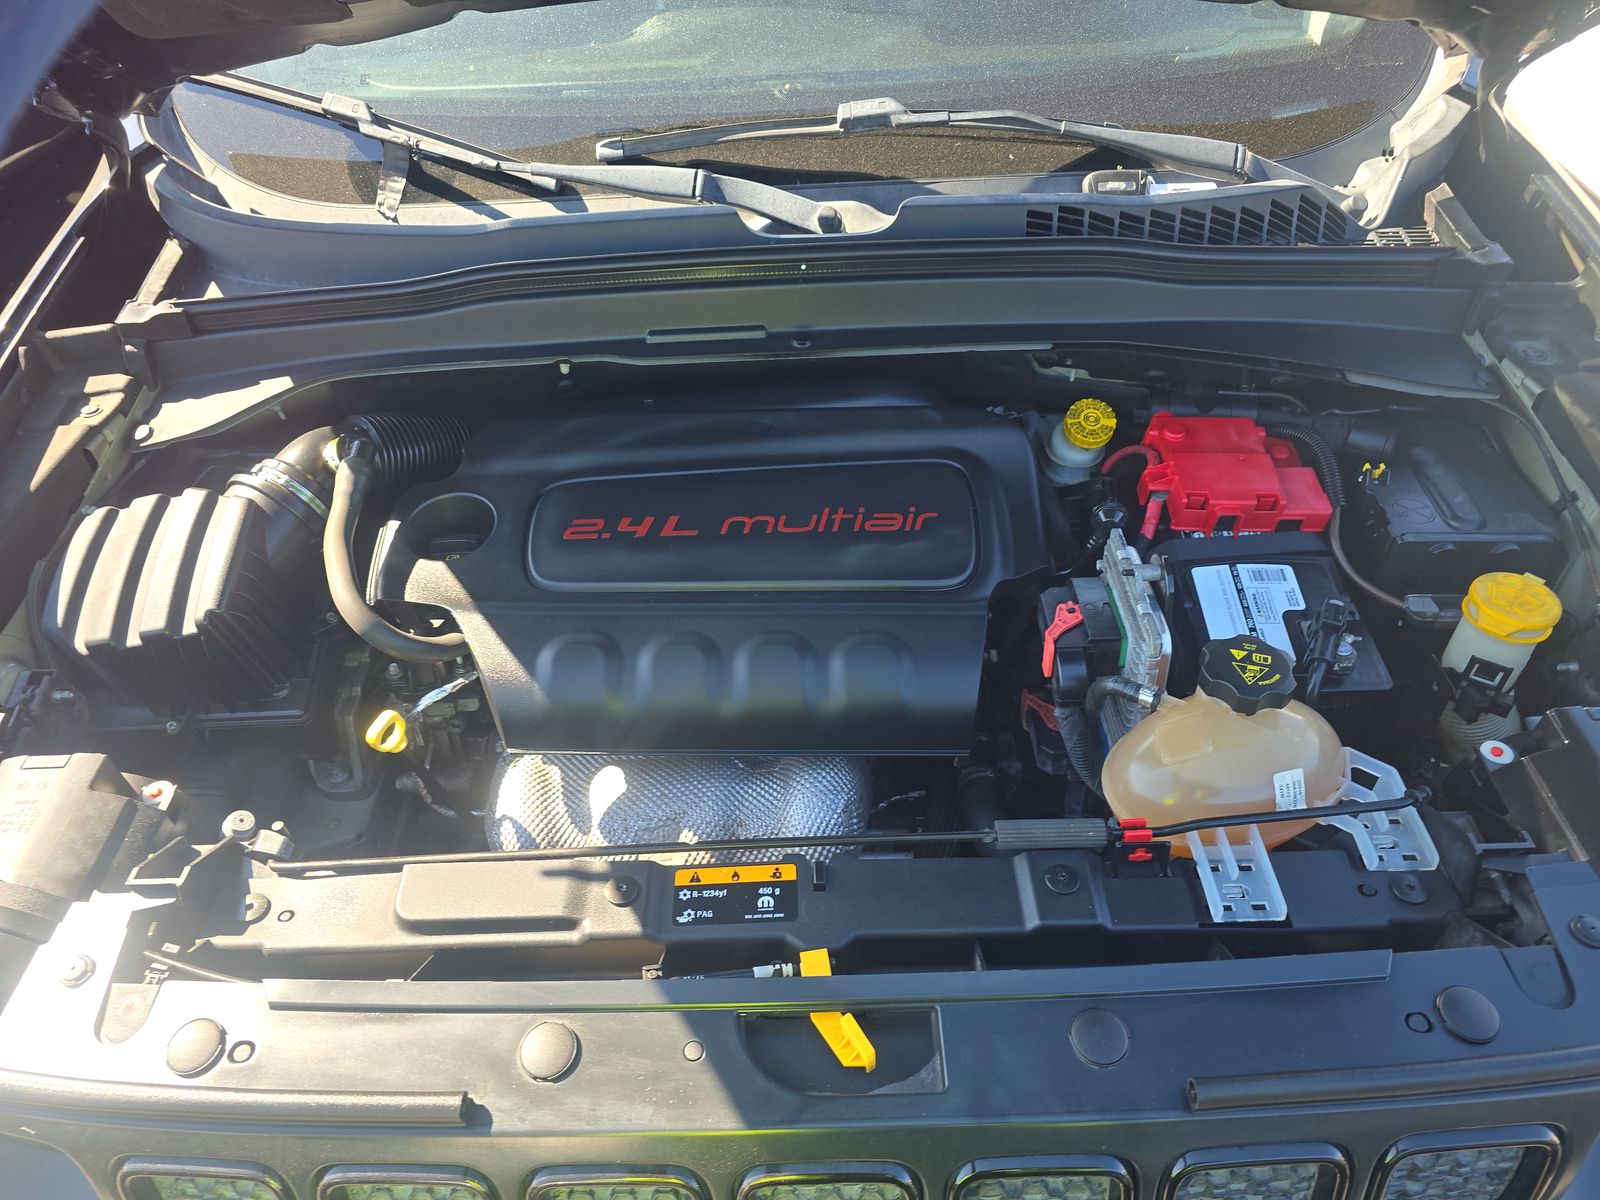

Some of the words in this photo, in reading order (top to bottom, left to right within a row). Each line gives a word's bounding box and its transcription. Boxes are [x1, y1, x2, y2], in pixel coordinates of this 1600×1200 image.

[720, 505, 938, 535] multiair
[692, 889, 727, 898] R-1234yf
[758, 887, 773, 895] 450
[774, 887, 781, 896] g
[696, 910, 713, 918] PAG
